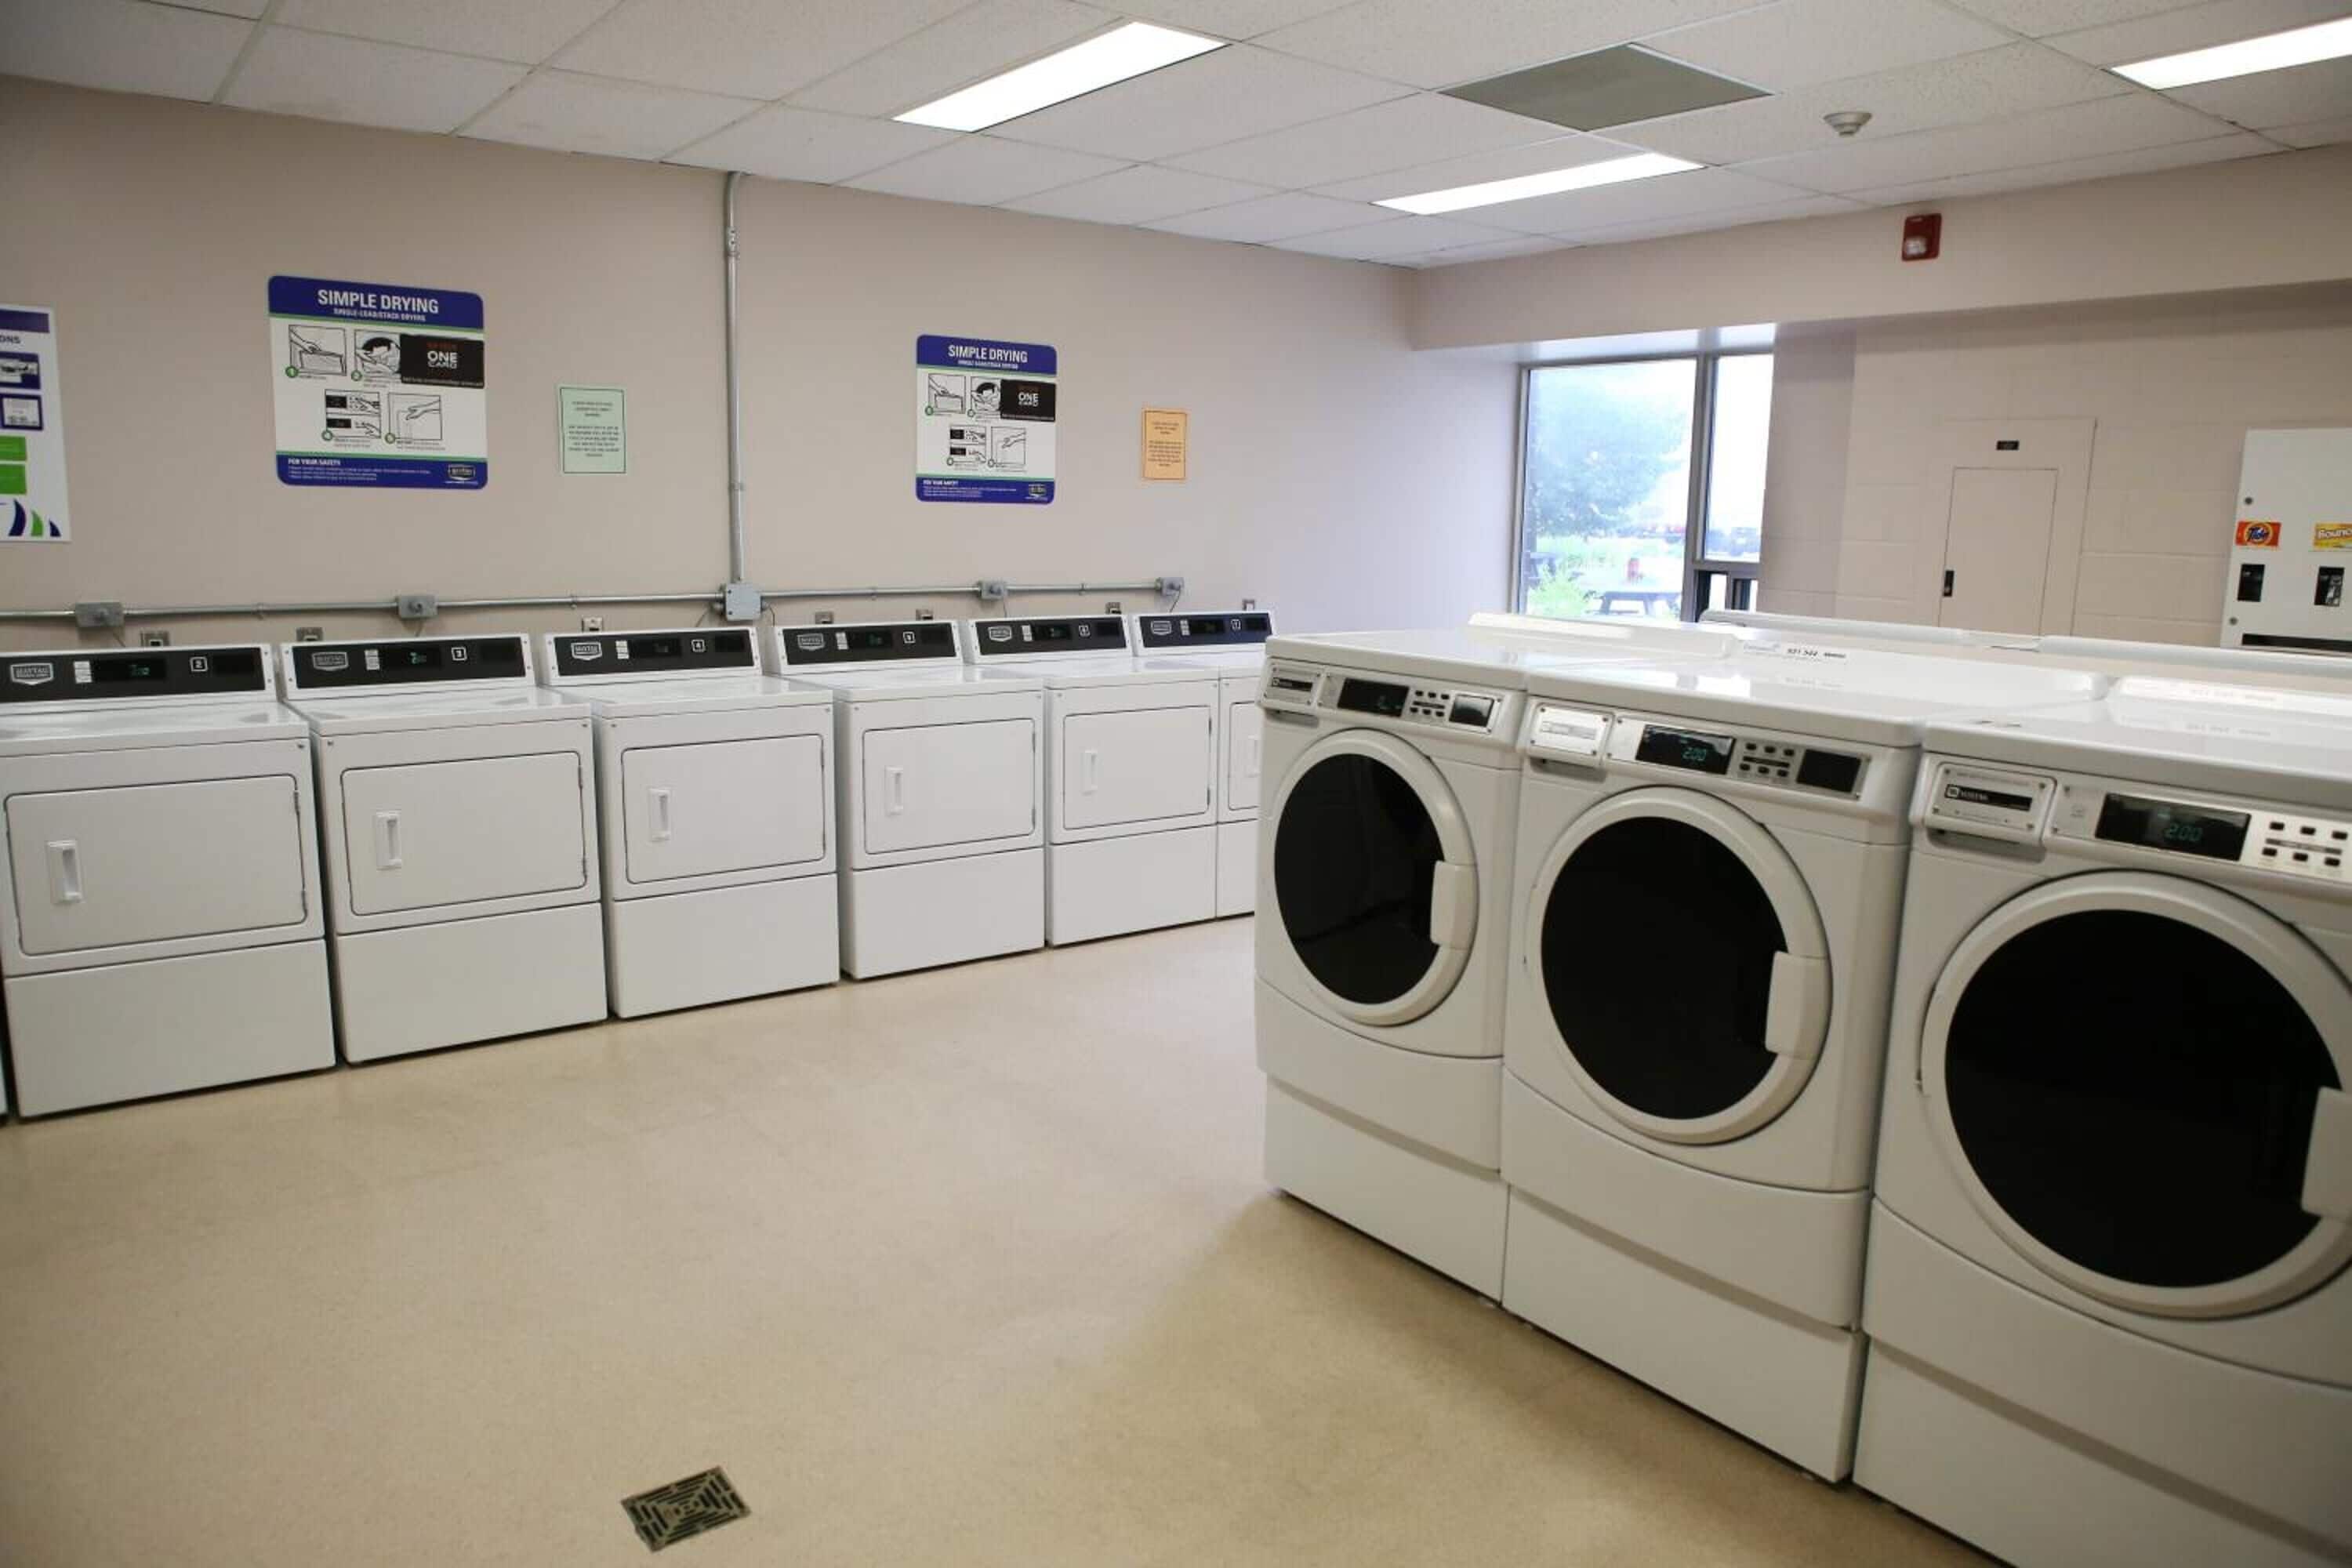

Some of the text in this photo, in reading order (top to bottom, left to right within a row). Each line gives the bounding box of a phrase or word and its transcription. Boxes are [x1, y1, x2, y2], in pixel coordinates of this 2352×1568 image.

[318, 289, 439, 314] SIMPLE DRYING
[427, 350, 458, 363] ONE
[948, 345, 1028, 363] SIMPLE DRYING
[1018, 392, 1039, 402] ONE
